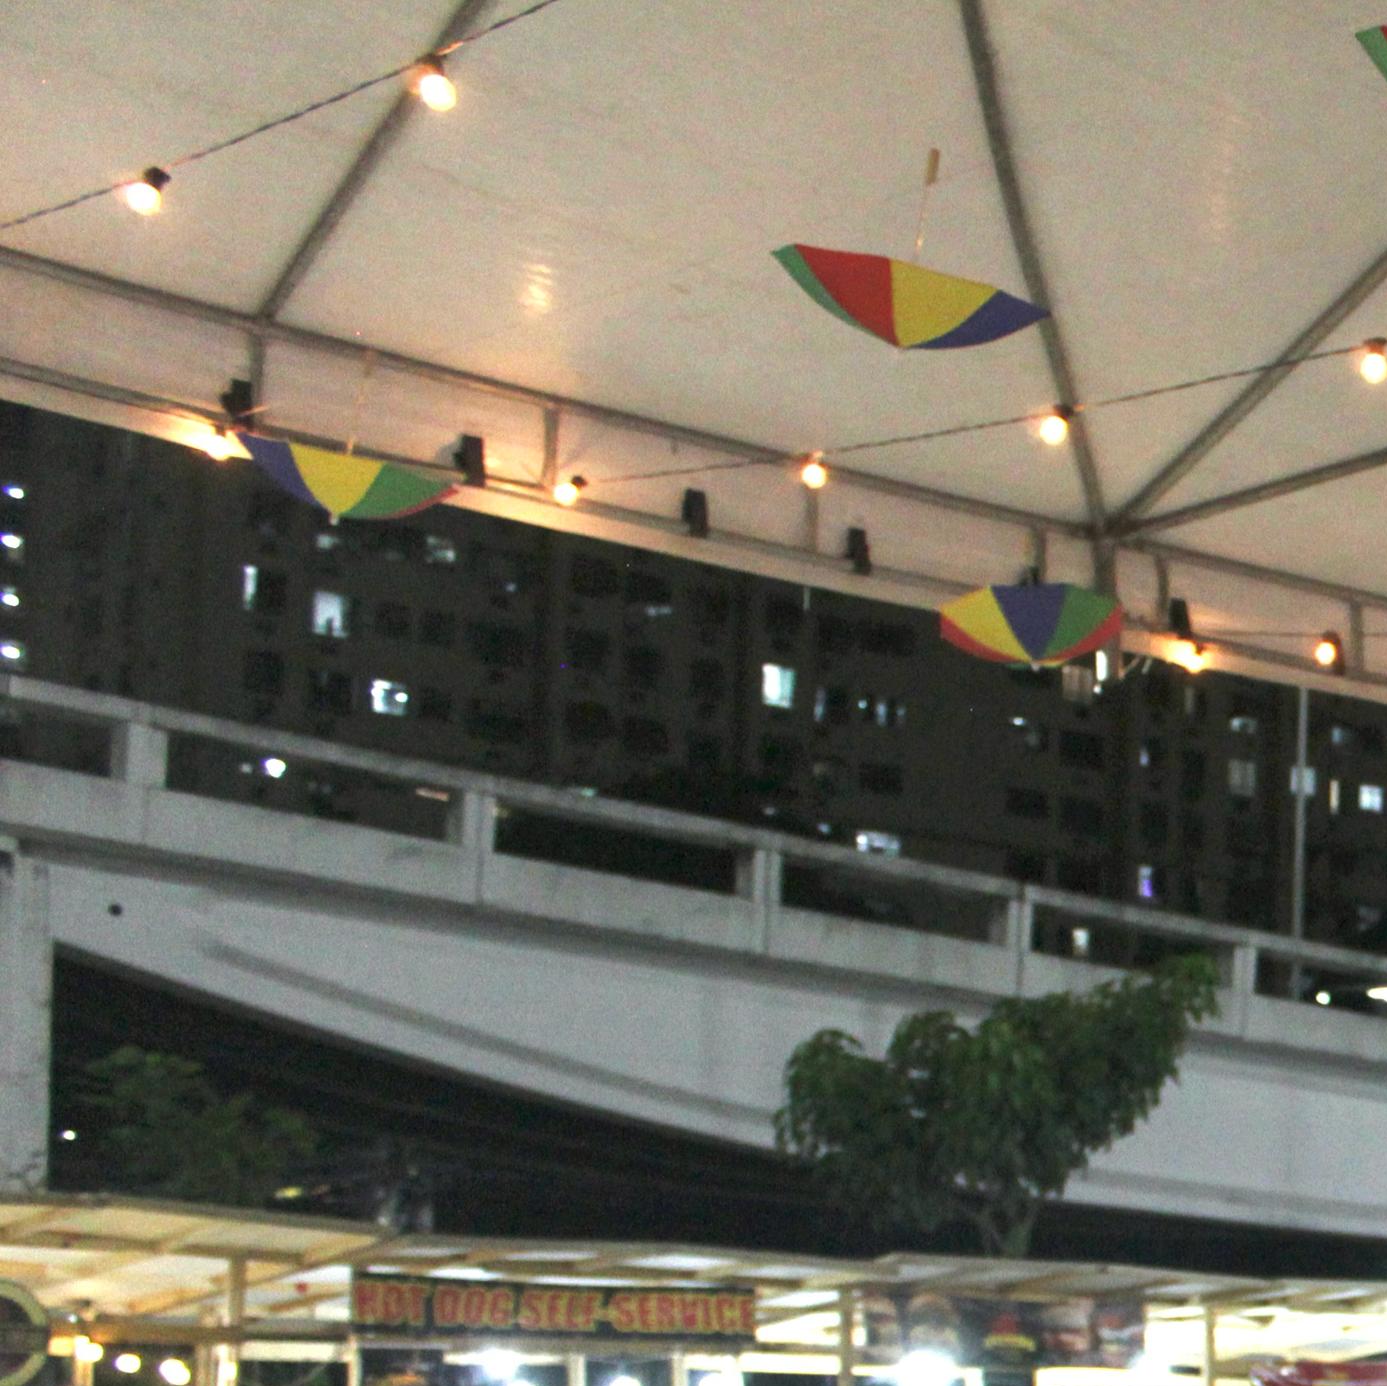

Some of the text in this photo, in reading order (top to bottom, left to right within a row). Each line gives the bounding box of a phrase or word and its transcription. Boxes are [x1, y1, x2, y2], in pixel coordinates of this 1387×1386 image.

[355, 1280, 755, 1335] HOT DOG SELF-SERVICE
